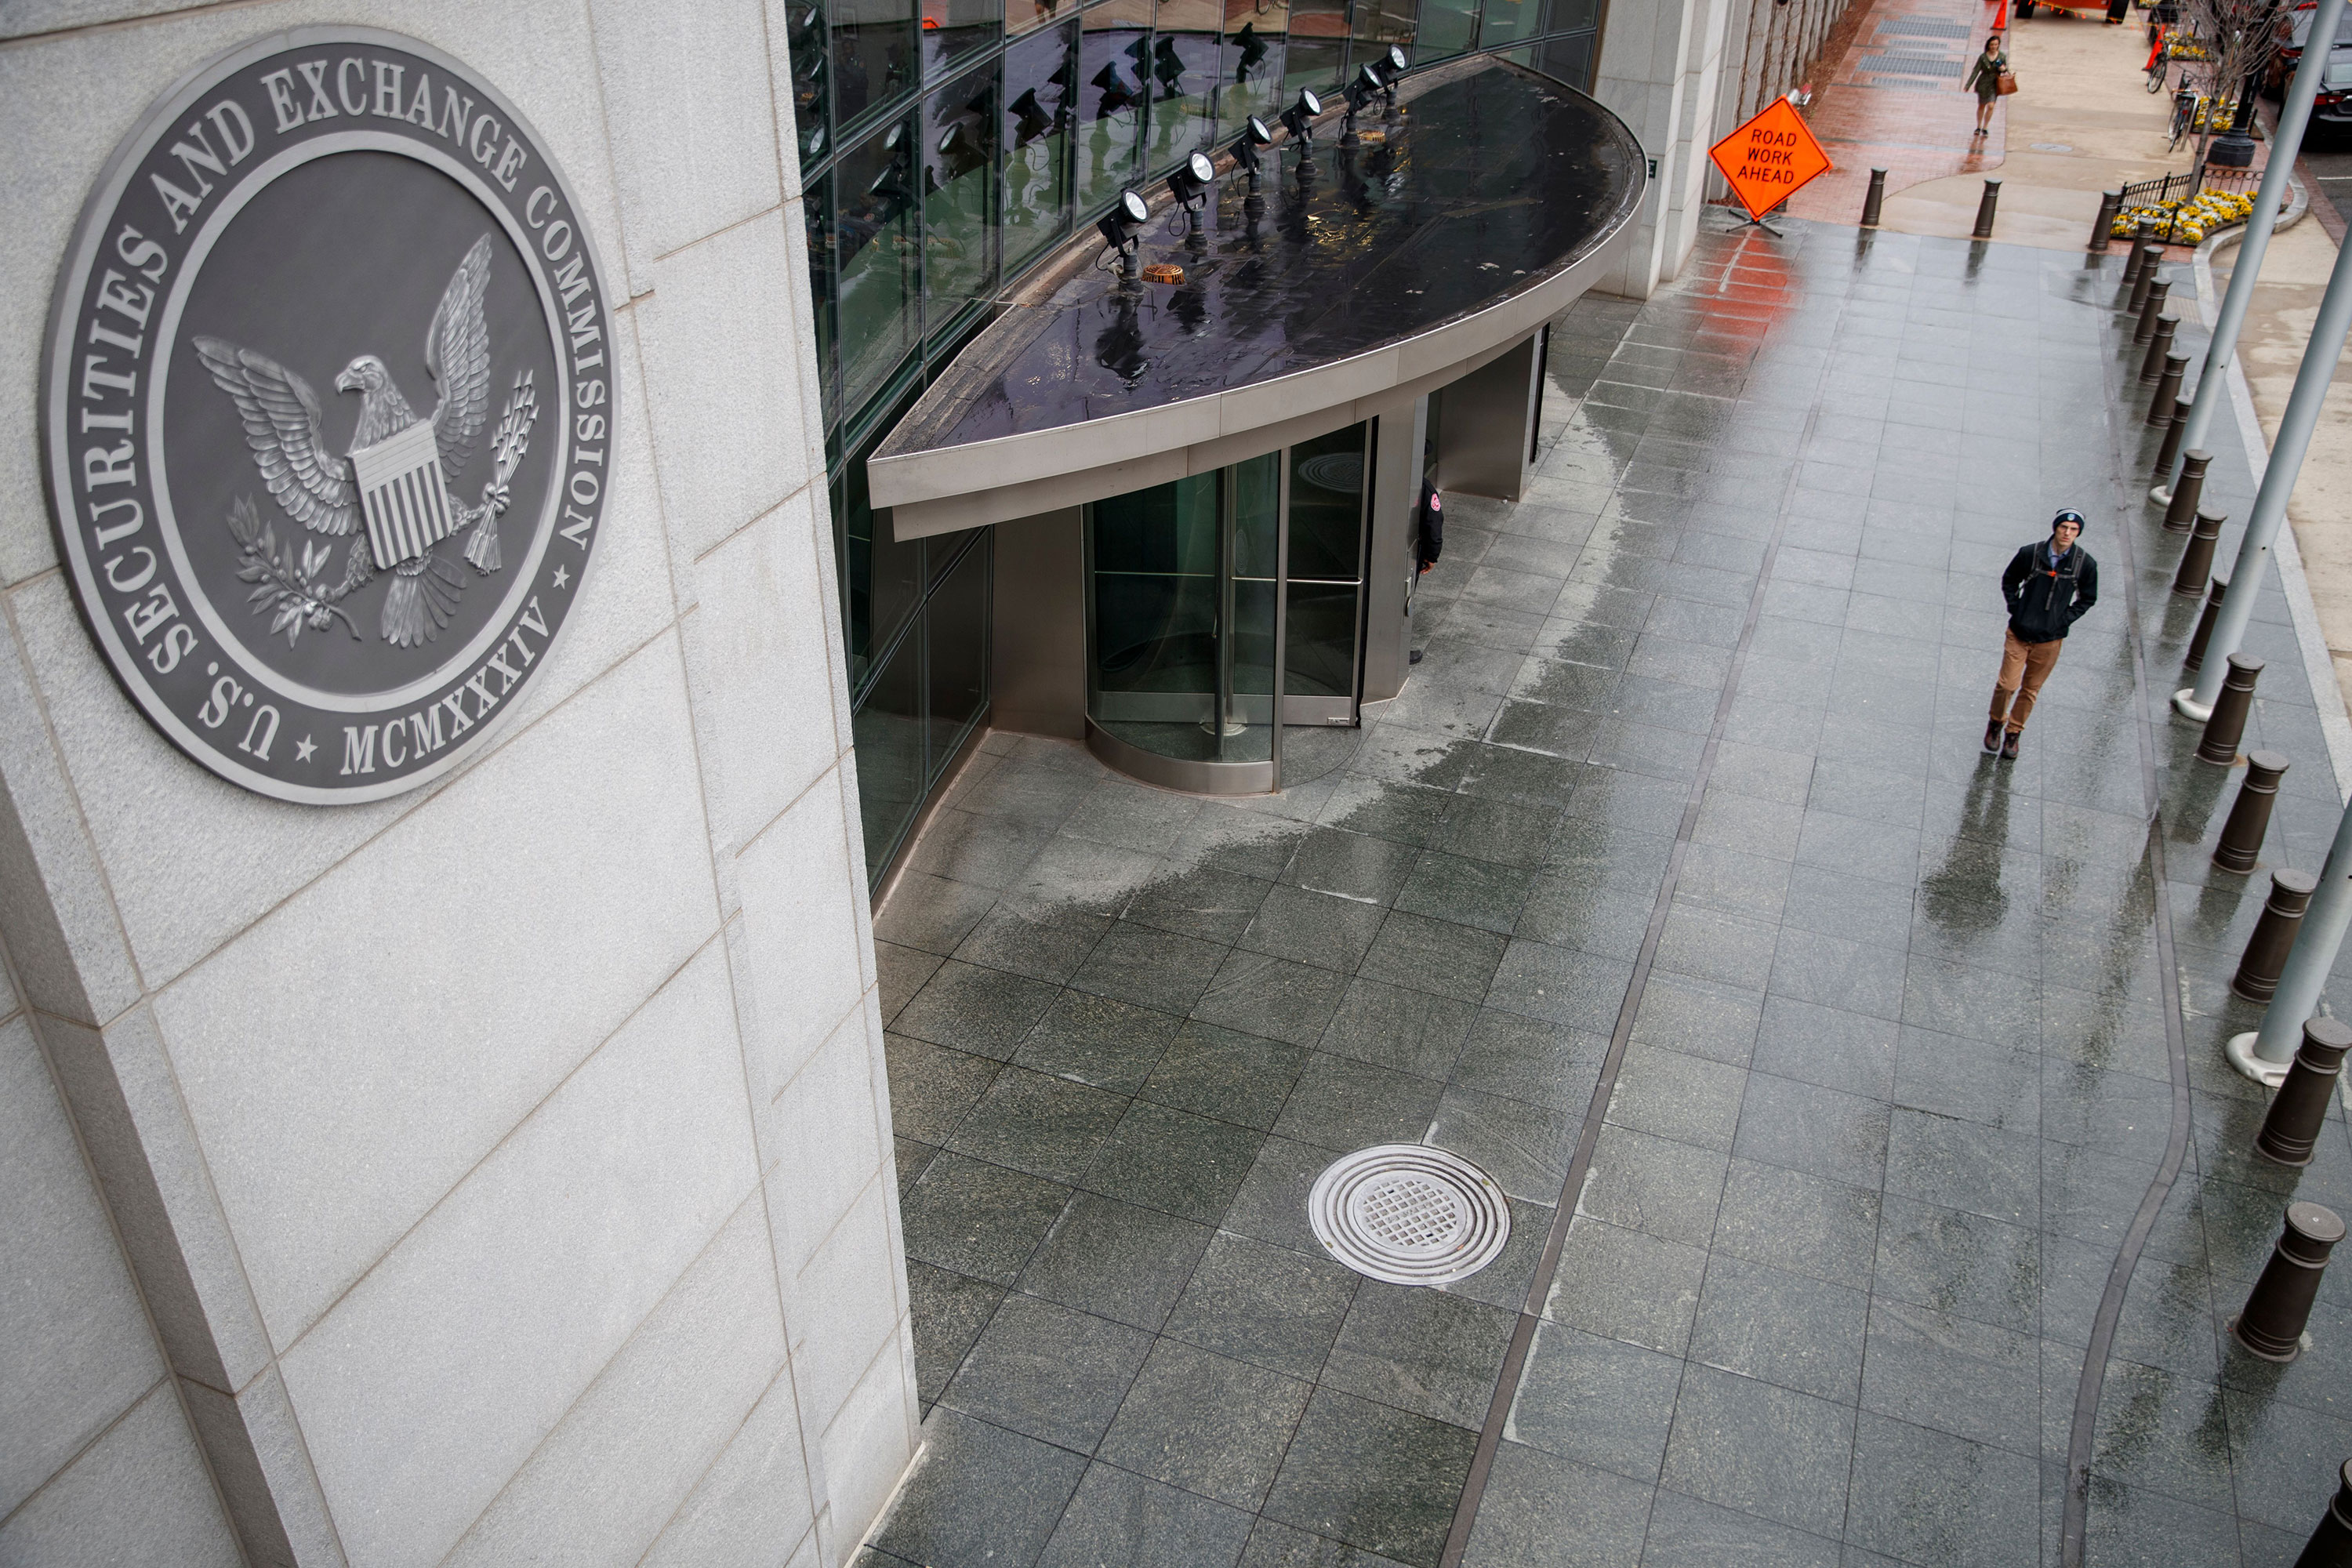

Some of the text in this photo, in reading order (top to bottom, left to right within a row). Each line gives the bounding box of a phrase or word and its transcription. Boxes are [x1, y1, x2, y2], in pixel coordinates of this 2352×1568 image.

[1751, 129, 1797, 147] ROAD
[1748, 147, 1793, 165] WORK
[1737, 165, 1794, 184] AHEAD
[82, 57, 605, 761] U.S. SECURITIES AND EXCHANGE COMMISSION
[339, 596, 550, 775] MCMXXXIV
